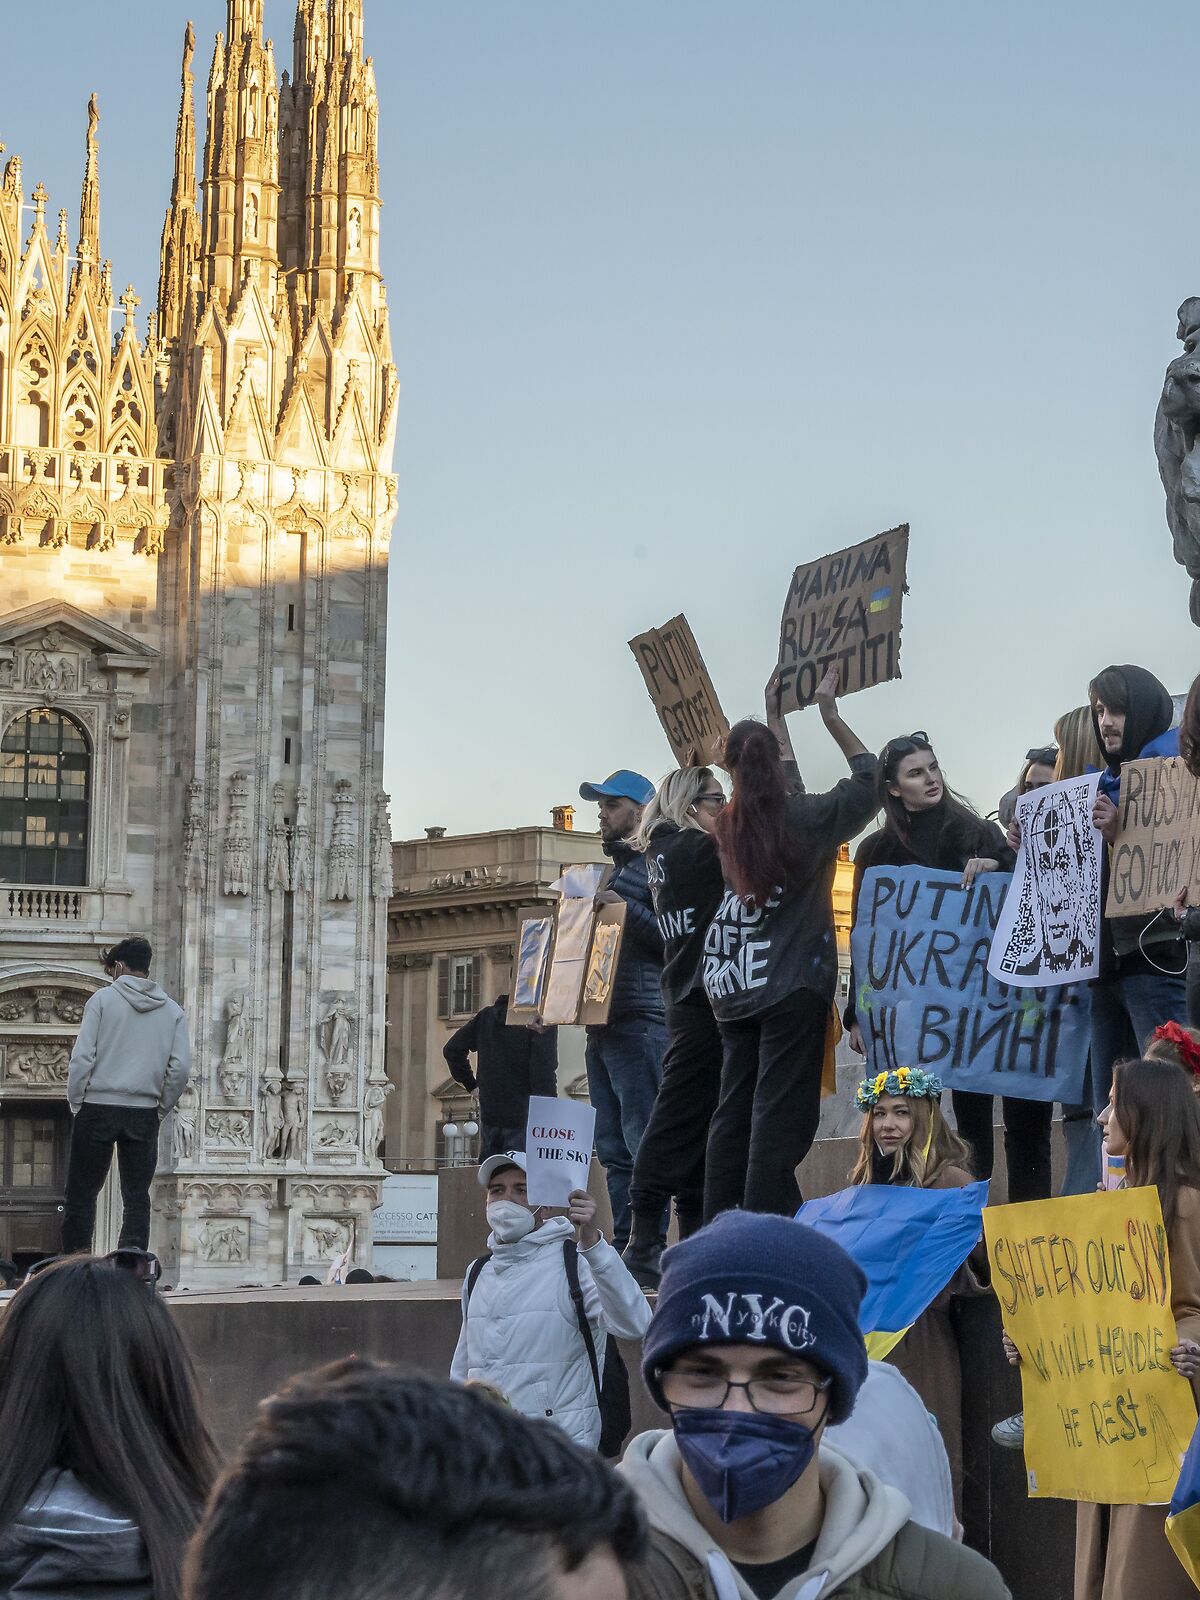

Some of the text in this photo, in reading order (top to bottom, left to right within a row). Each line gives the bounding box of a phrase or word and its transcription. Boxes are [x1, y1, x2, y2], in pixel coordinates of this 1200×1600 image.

[787, 542, 891, 613] MARINA
[780, 597, 869, 664] RUSSA
[776, 631, 894, 719] FOTTITI
[1113, 843, 1146, 905] GO
[871, 877, 1008, 930] PUTIN
[532, 1127, 576, 1141] CLOSE
[536, 1147, 589, 1166] THE SKY
[373, 1212, 413, 1221] ACCESSO
[699, 1293, 811, 1349] NYC
